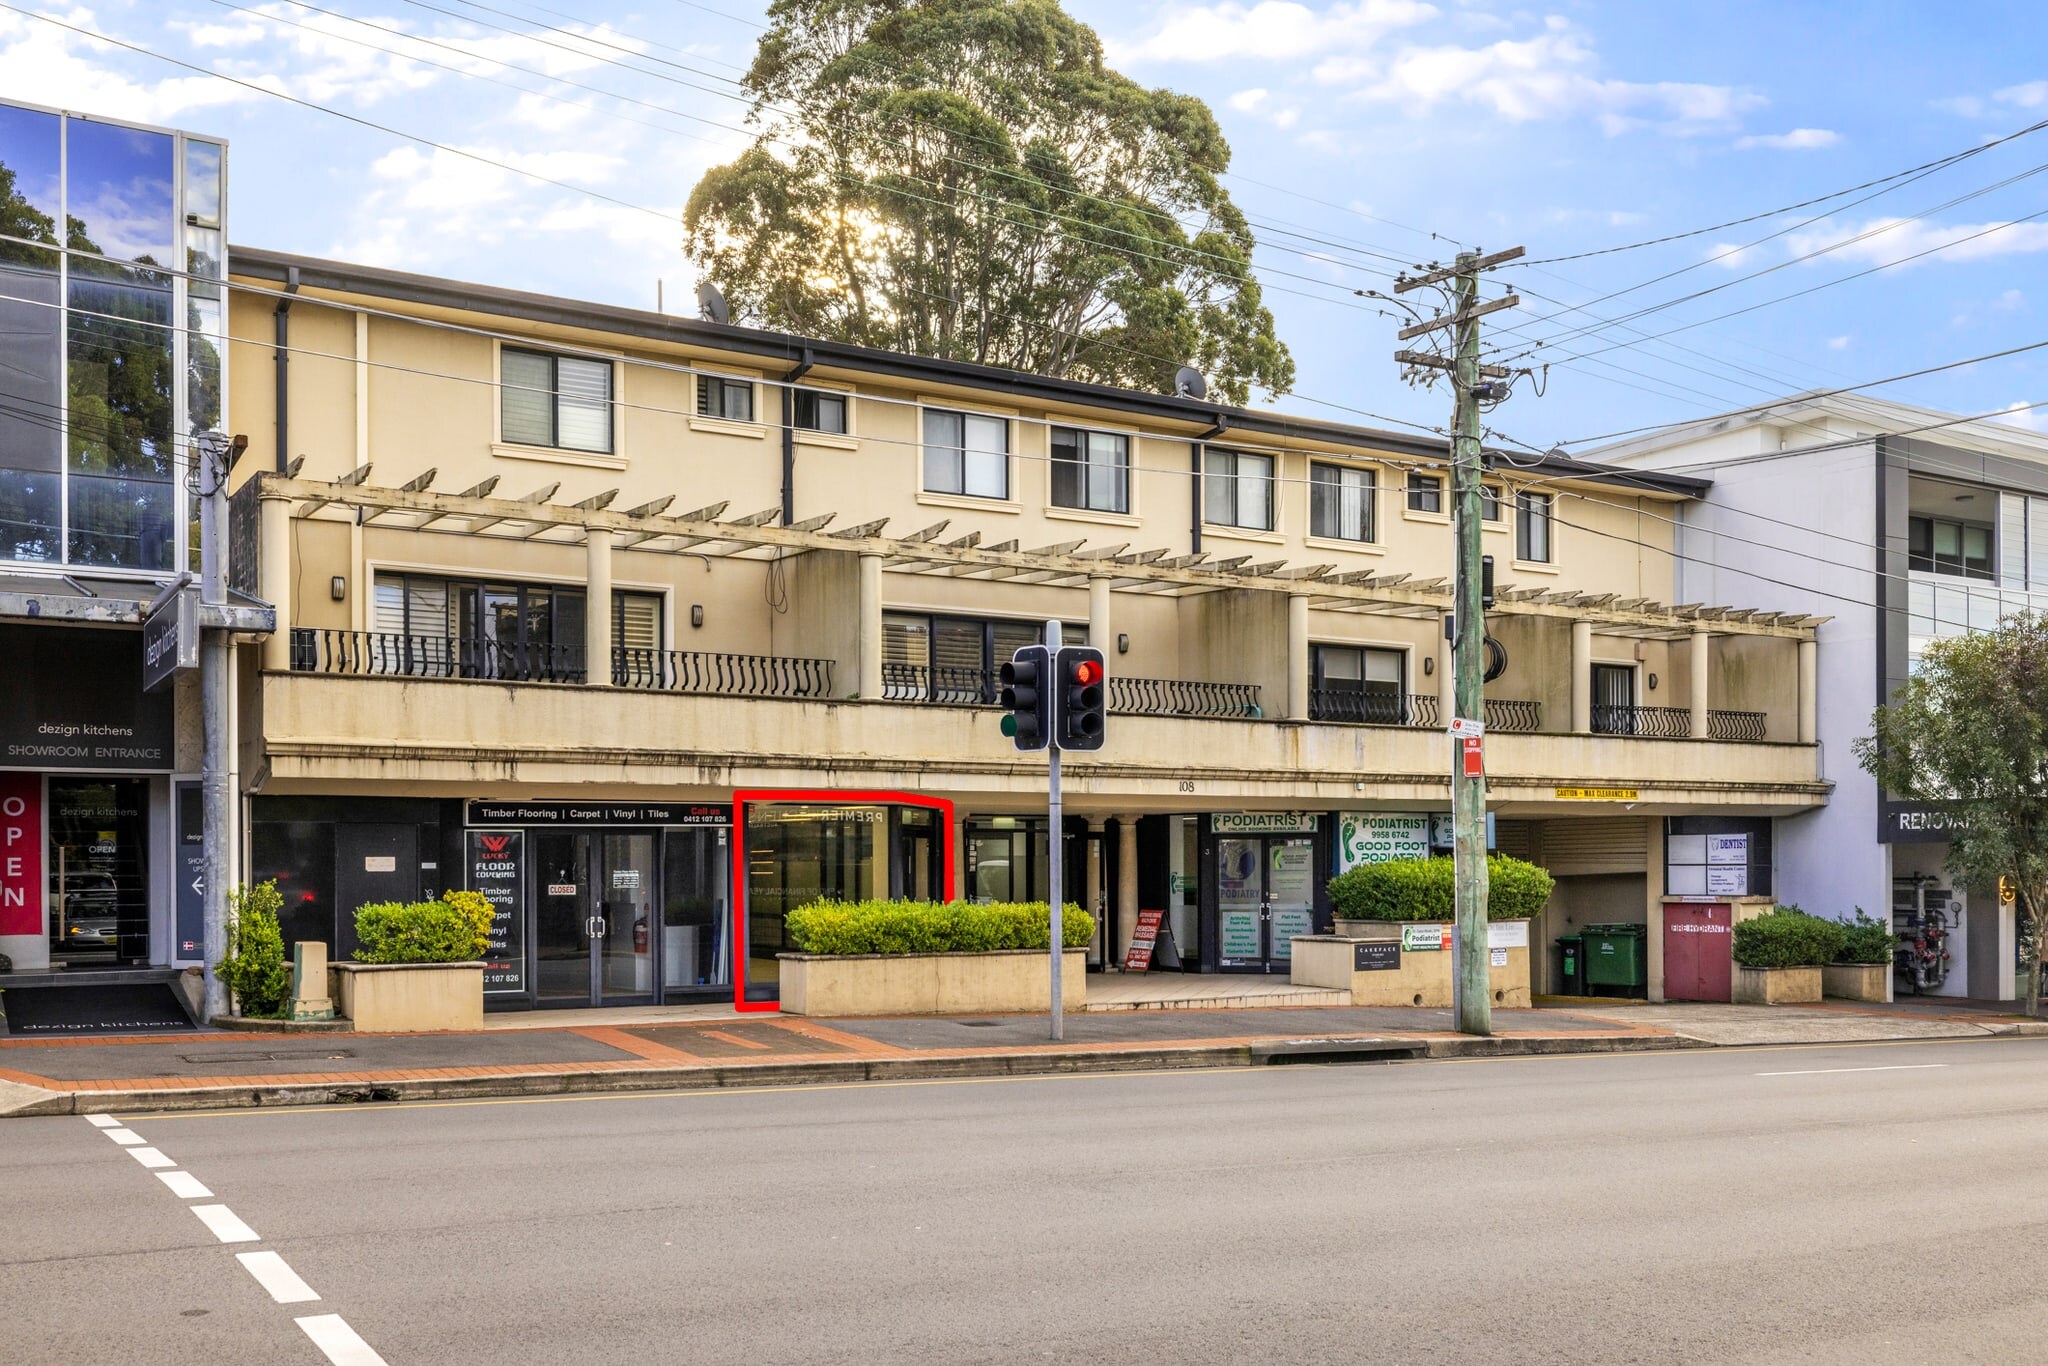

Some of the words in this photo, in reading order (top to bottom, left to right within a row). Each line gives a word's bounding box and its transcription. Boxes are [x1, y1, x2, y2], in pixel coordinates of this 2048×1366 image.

[38, 723, 79, 737] dezign
[83, 724, 133, 736] kitchens
[8, 745, 88, 757] SHOWROOM
[95, 748, 161, 759] ENTRANCE
[1179, 781, 1195, 792] 108
[1556, 789, 1578, 797] CAUTION
[60, 808, 94, 818] dezign
[97, 807, 138, 816] kitchens
[482, 808, 515, 818] Timber
[518, 809, 557, 820] Flooring
[570, 810, 601, 820] Carpet
[613, 810, 636, 819] Vinyl
[648, 810, 669, 818] Tiles
[691, 808, 710, 816] Call
[1223, 814, 1305, 826] PODIATRIST
[1362, 818, 1428, 829] PODIATRIST
[1355, 841, 1392, 851] GOOD
[1395, 841, 1428, 850] FOOT
[1720, 839, 1745, 849] DENTIST
[475, 862, 515, 871] FLOOR
[479, 887, 511, 895] Timber
[490, 926, 507, 936] inyl
[1688, 924, 1724, 932] HYDRANT
[488, 940, 506, 948] iles
[492, 975, 504, 983] 107
[506, 974, 519, 982] 826
